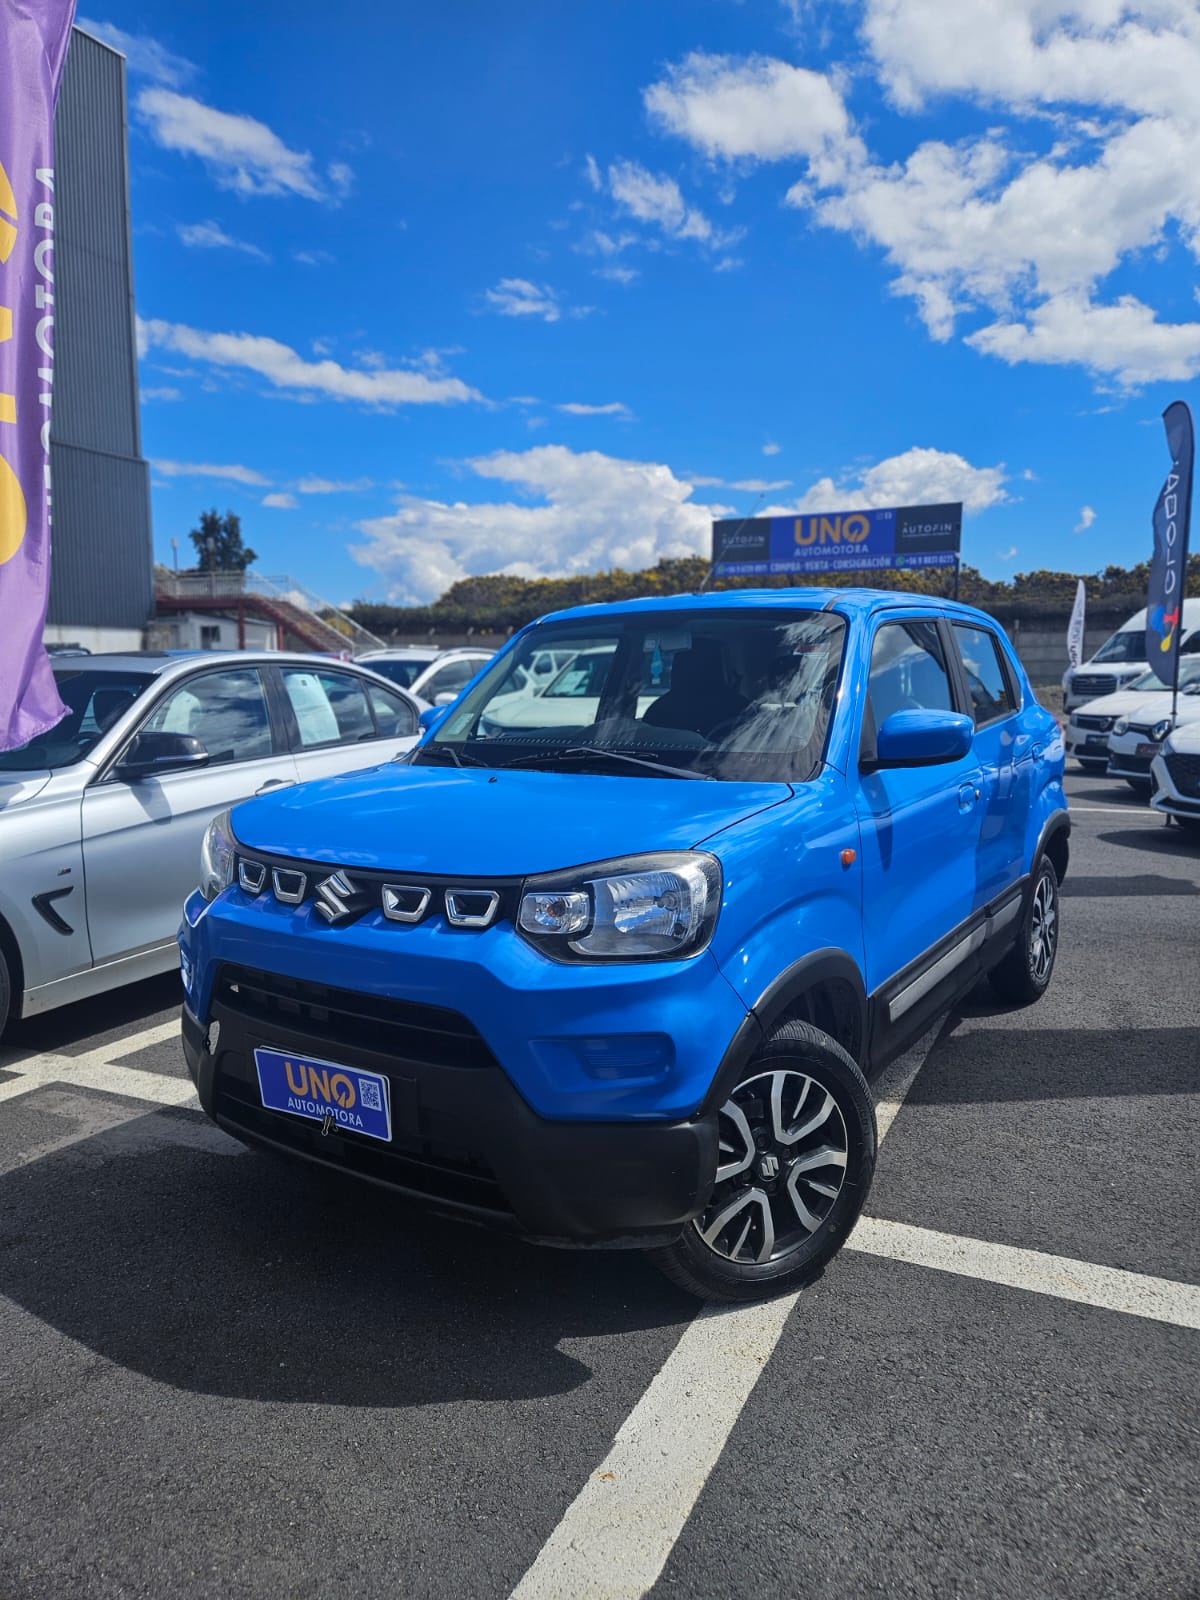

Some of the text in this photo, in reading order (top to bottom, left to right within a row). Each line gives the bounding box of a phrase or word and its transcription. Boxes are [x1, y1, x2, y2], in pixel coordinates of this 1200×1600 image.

[794, 514, 871, 546] UNO
[793, 544, 870, 557] AUTOMOTORA
[285, 1062, 356, 1108] UNO
[287, 1097, 364, 1127] AUTOMOTORA
